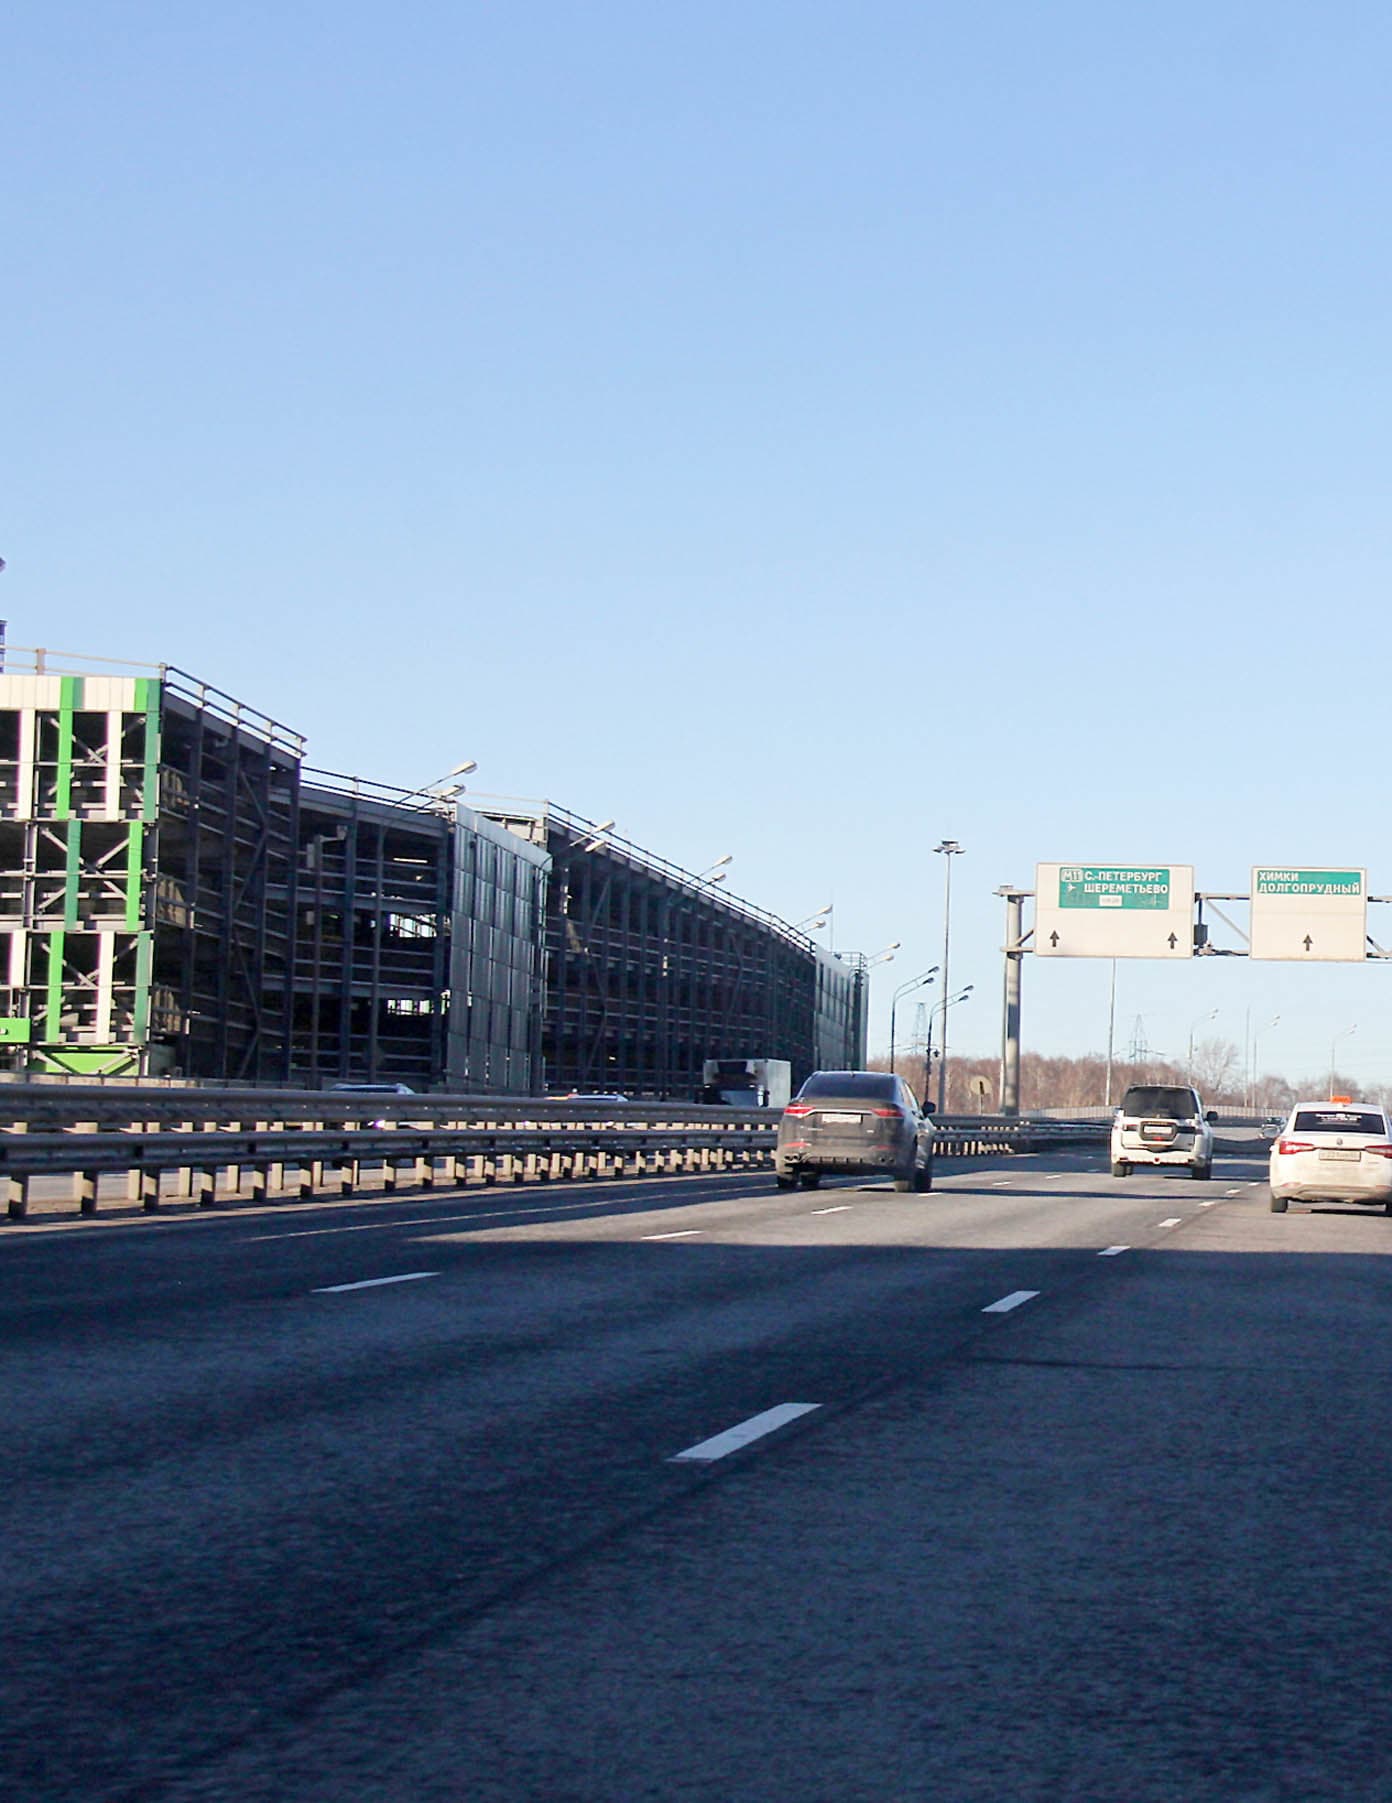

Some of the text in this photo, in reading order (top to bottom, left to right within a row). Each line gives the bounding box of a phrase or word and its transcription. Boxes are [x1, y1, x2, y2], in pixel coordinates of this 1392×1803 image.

[1259, 871, 1299, 882] ХИМКИ
[1083, 882, 1169, 894] ШЕРЕМЕТЬЕВО
[1259, 880, 1360, 895] ДОЛГОПРУДНЫЙ
